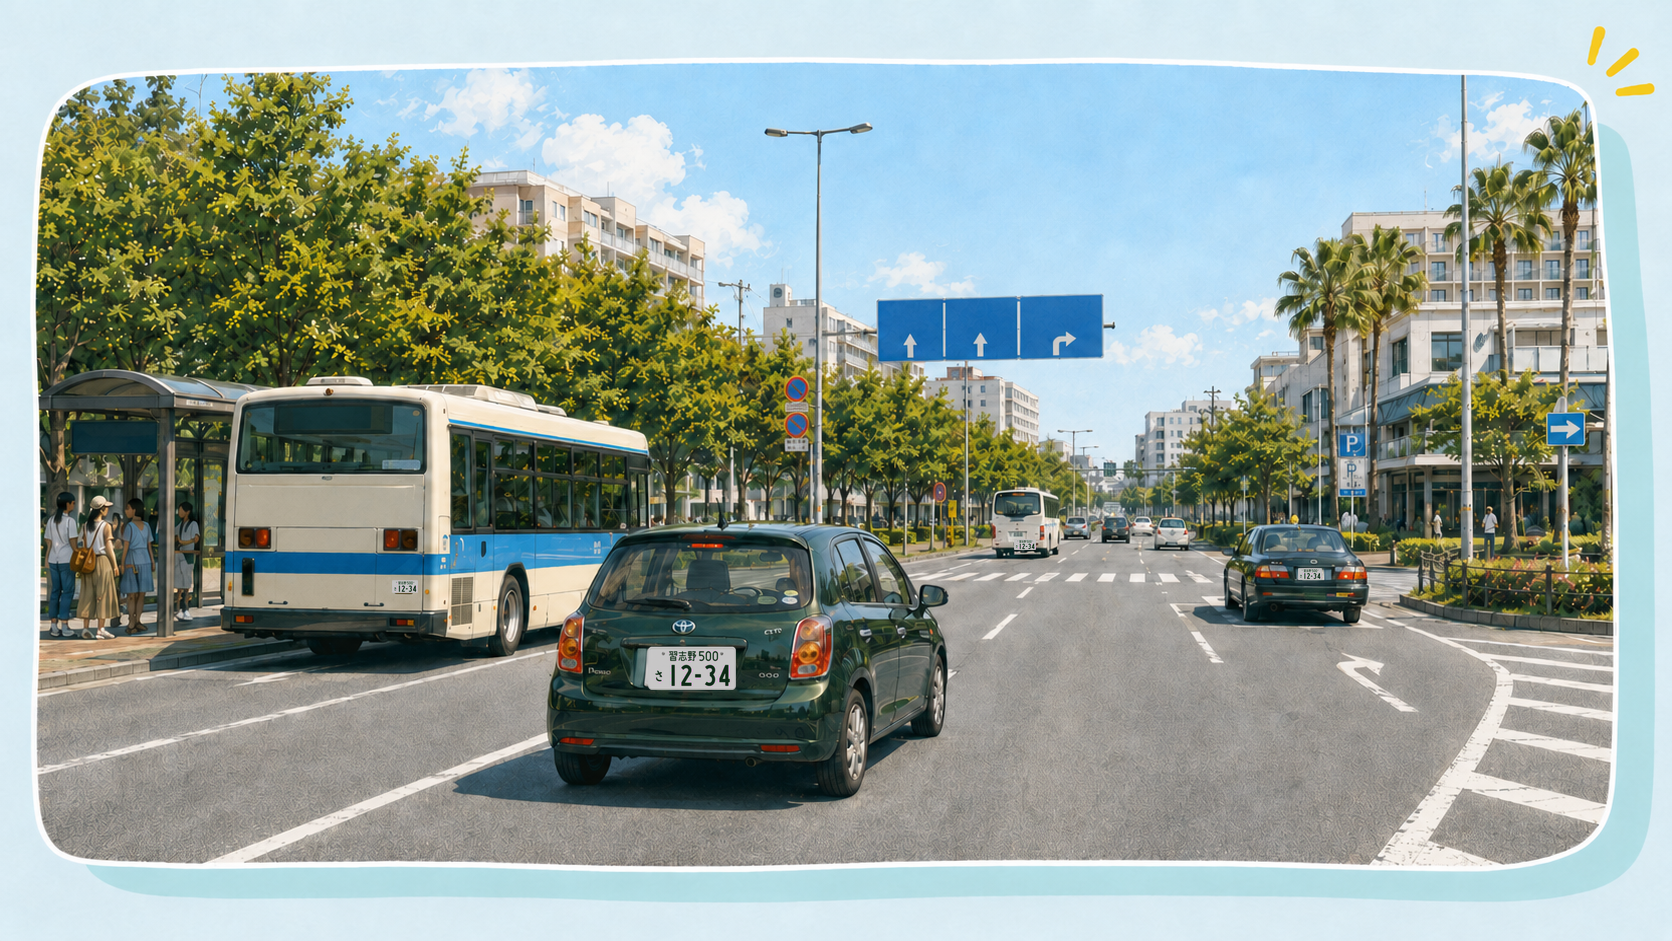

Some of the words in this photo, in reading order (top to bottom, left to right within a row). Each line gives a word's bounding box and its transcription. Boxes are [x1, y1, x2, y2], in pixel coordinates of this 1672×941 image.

[1346, 435, 1358, 453] P
[1303, 572, 1321, 580] 12-34
[398, 585, 417, 593] 12-34
[668, 650, 697, 662] 習志野
[698, 650, 719, 662] 500
[655, 670, 663, 682] さ
[671, 664, 731, 687] 12-34
